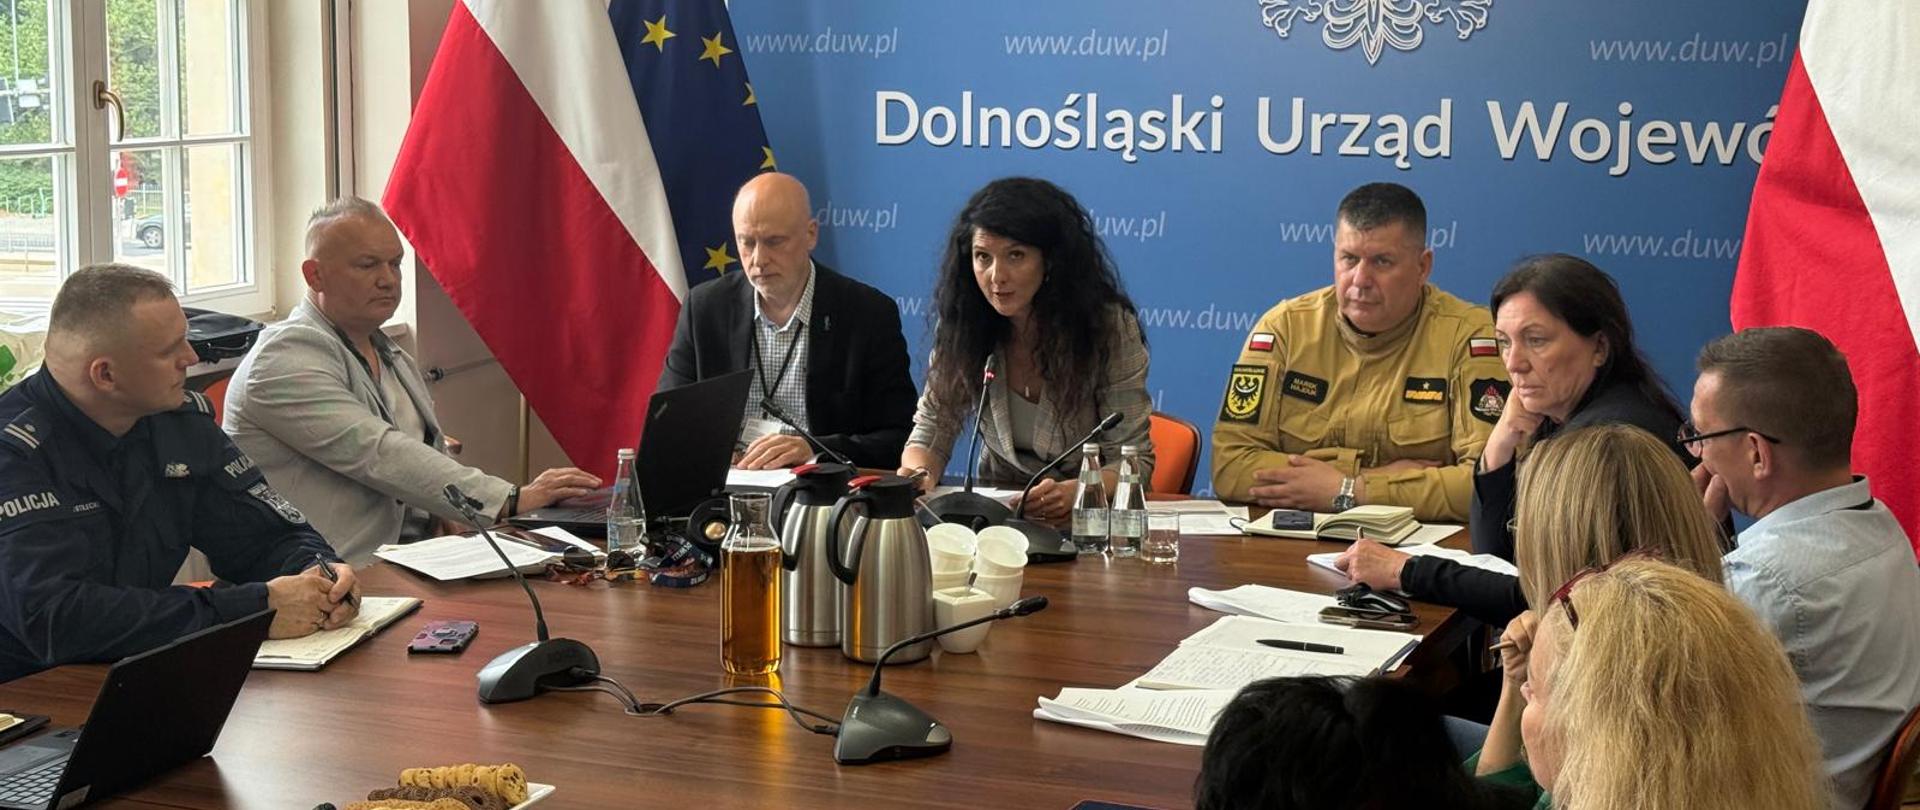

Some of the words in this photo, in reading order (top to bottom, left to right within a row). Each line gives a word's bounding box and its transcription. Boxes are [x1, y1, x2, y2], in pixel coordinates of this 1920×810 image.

[746, 27, 898, 58] www.duw.pl
[1004, 29, 1168, 61] www.duw.pl
[1589, 32, 1787, 68] www.duw.pl
[875, 90, 1225, 162] Dolnośląski
[1257, 96, 1453, 169] Urząd
[1089, 209, 1166, 242] uw.pl
